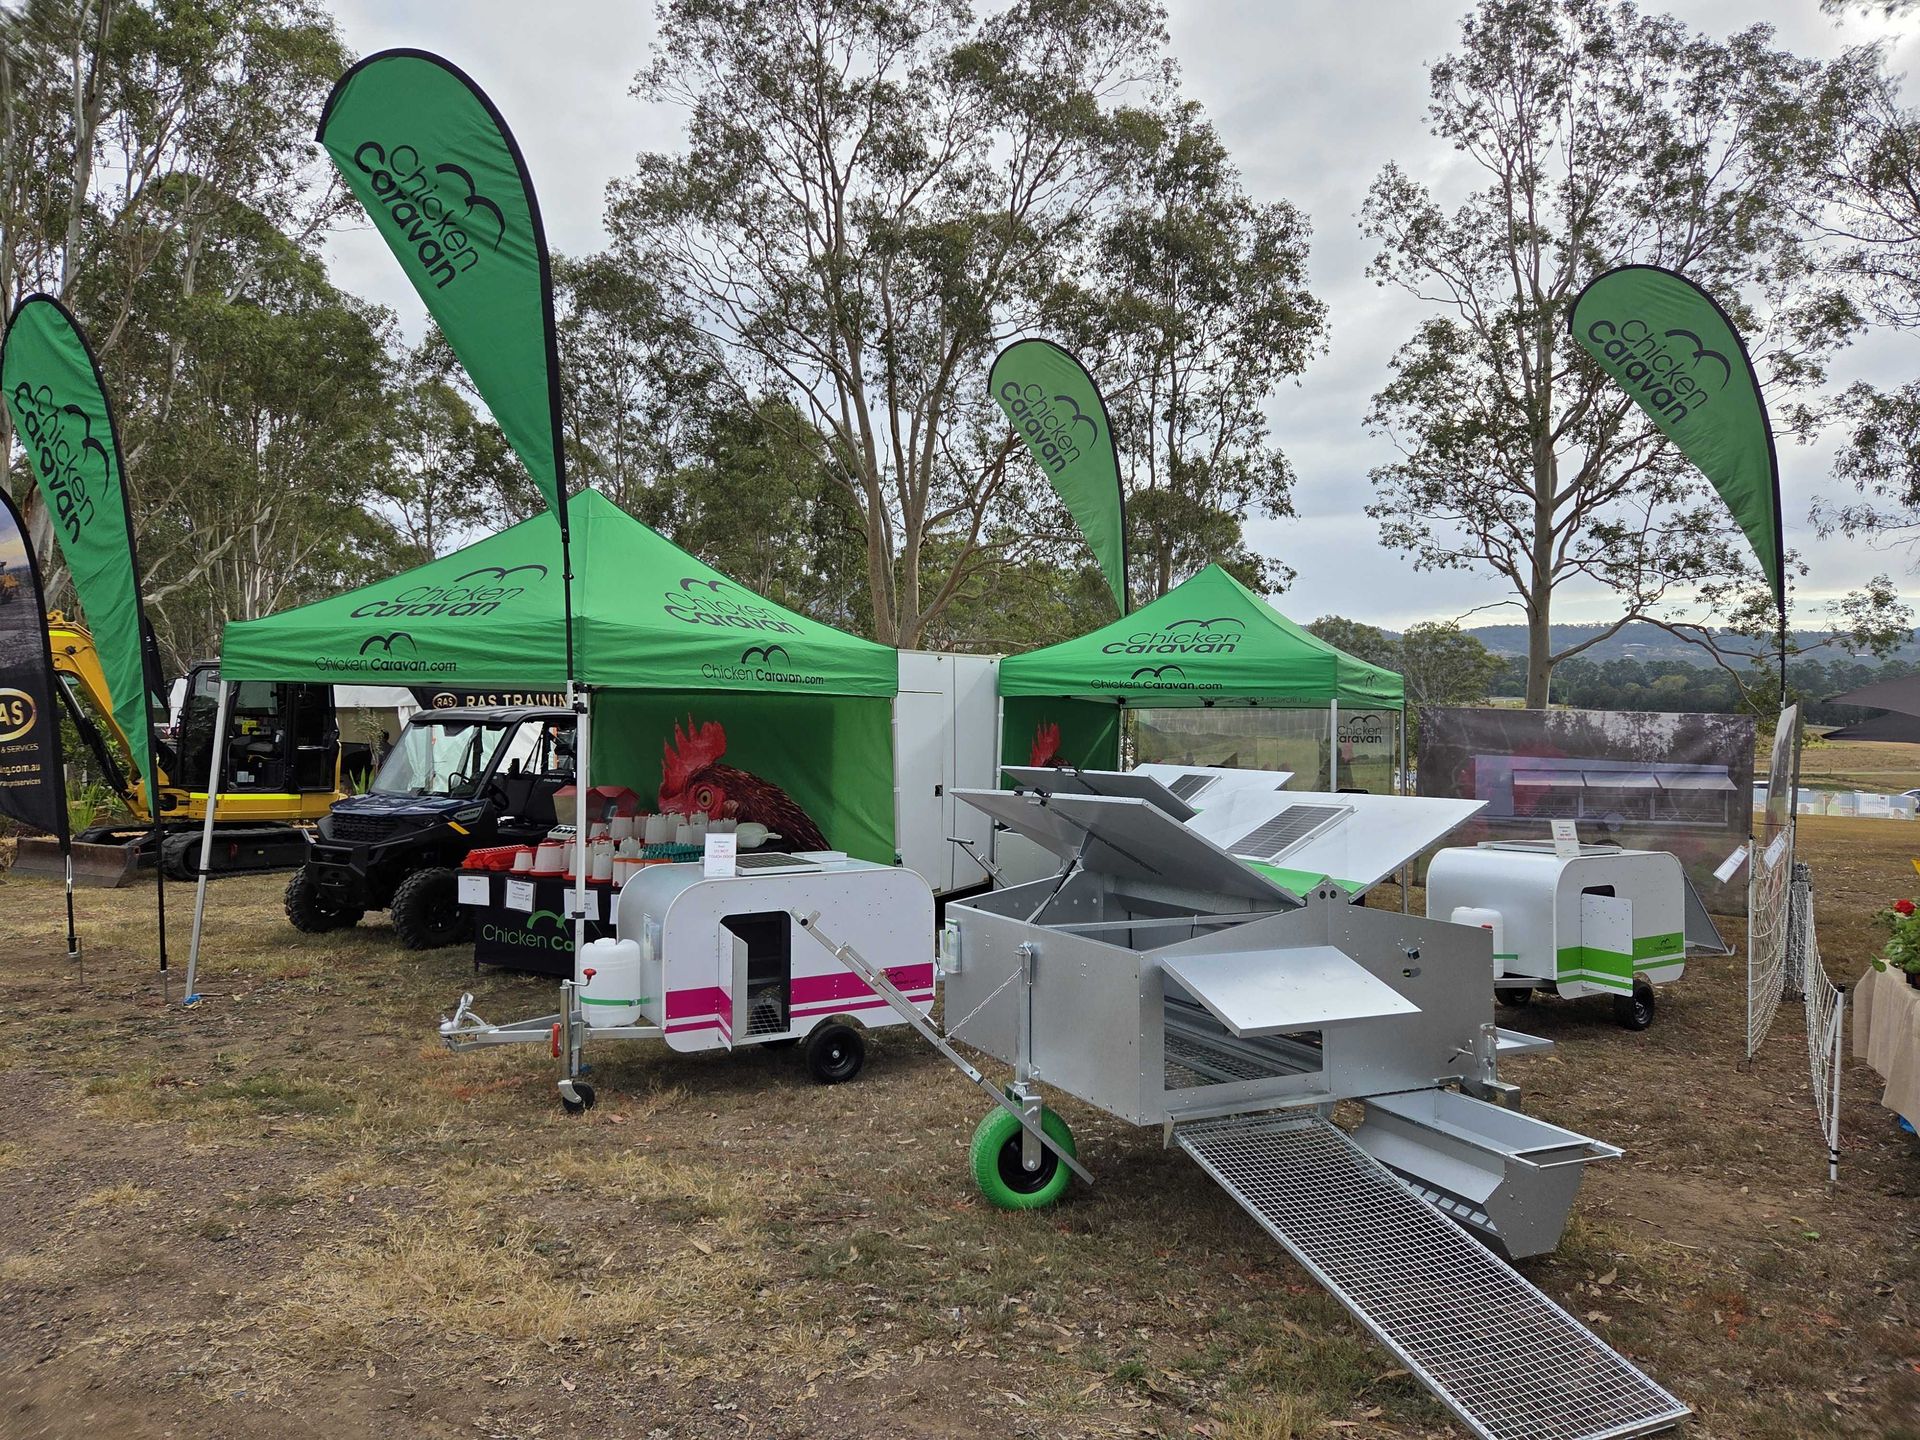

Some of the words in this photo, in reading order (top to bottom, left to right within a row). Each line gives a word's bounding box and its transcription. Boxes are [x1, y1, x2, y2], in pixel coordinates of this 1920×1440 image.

[390, 145, 479, 273] Chicken
[1621, 319, 1708, 410] Chicken
[1024, 384, 1080, 463] Chicken
[34, 385, 95, 526] Chicken
[395, 584, 525, 603] Chicken
[350, 601, 501, 618] Caravan
[664, 591, 786, 621] Chicken
[664, 605, 805, 635] Caravan
[1128, 632, 1241, 644] Chicken
[1102, 642, 1237, 654] Caravan
[314, 656, 368, 671] Chicken
[371, 658, 457, 672] Caravan.com
[701, 663, 754, 681] Chicken
[756, 668, 824, 685] Caravan.com
[1091, 679, 1143, 689] Chicken
[1144, 680, 1223, 690] Caravan.com
[436, 697, 453, 706] RAS
[466, 694, 497, 707] RAS
[503, 694, 568, 707] TRAININ
[0, 700, 24, 725] AS
[1337, 725, 1381, 735] Chicken
[1337, 735, 1382, 744] aravan
[482, 924, 547, 949] Chicken
